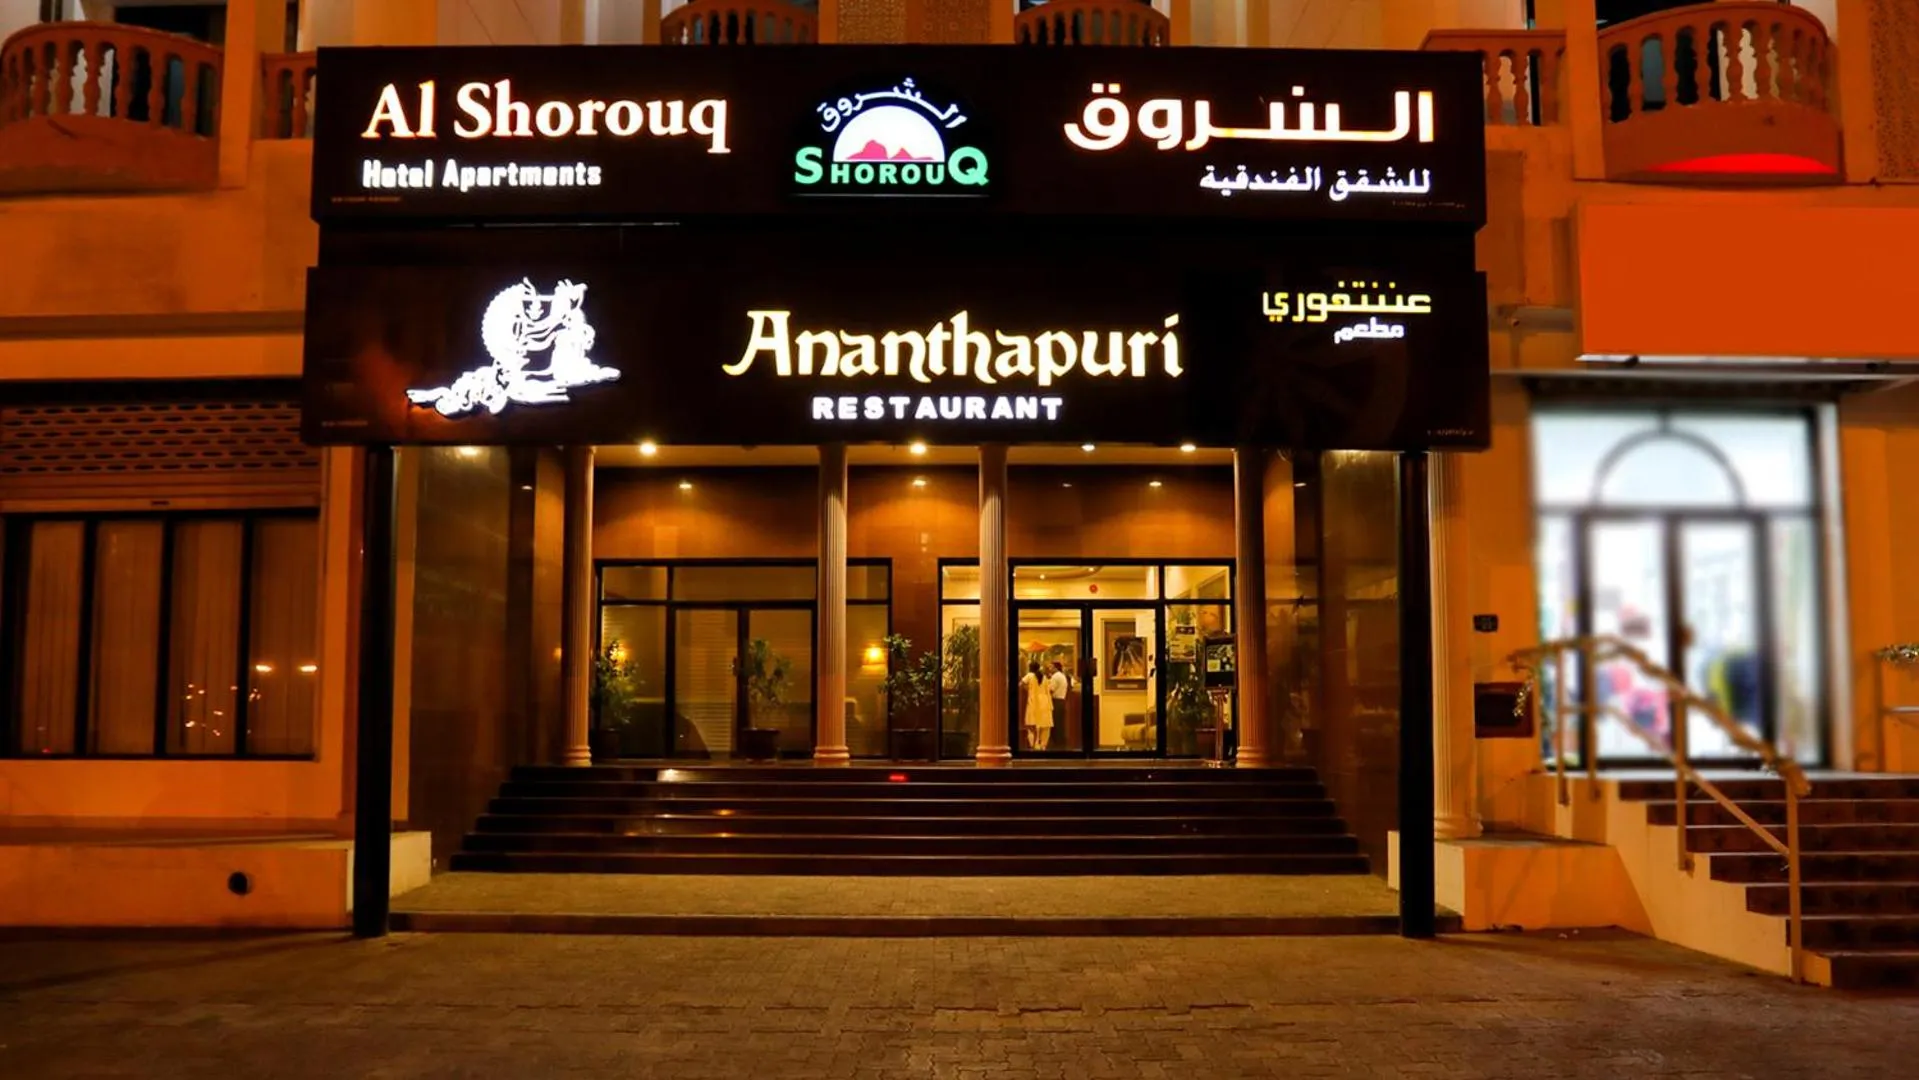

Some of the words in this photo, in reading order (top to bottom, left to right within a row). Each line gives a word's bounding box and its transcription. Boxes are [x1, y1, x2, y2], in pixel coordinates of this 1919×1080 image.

[361, 80, 437, 139] Al
[453, 78, 731, 154] Shorouq
[816, 77, 968, 132] الشروق
[362, 159, 435, 189] Hotel
[441, 158, 603, 193] Apartments
[1199, 164, 1322, 197] الفندقية
[1328, 166, 1431, 201] للشقق
[1333, 315, 1406, 345] مطعم
[721, 309, 1185, 387] Ananthapuri
[812, 396, 1063, 421] RESTAURANT
